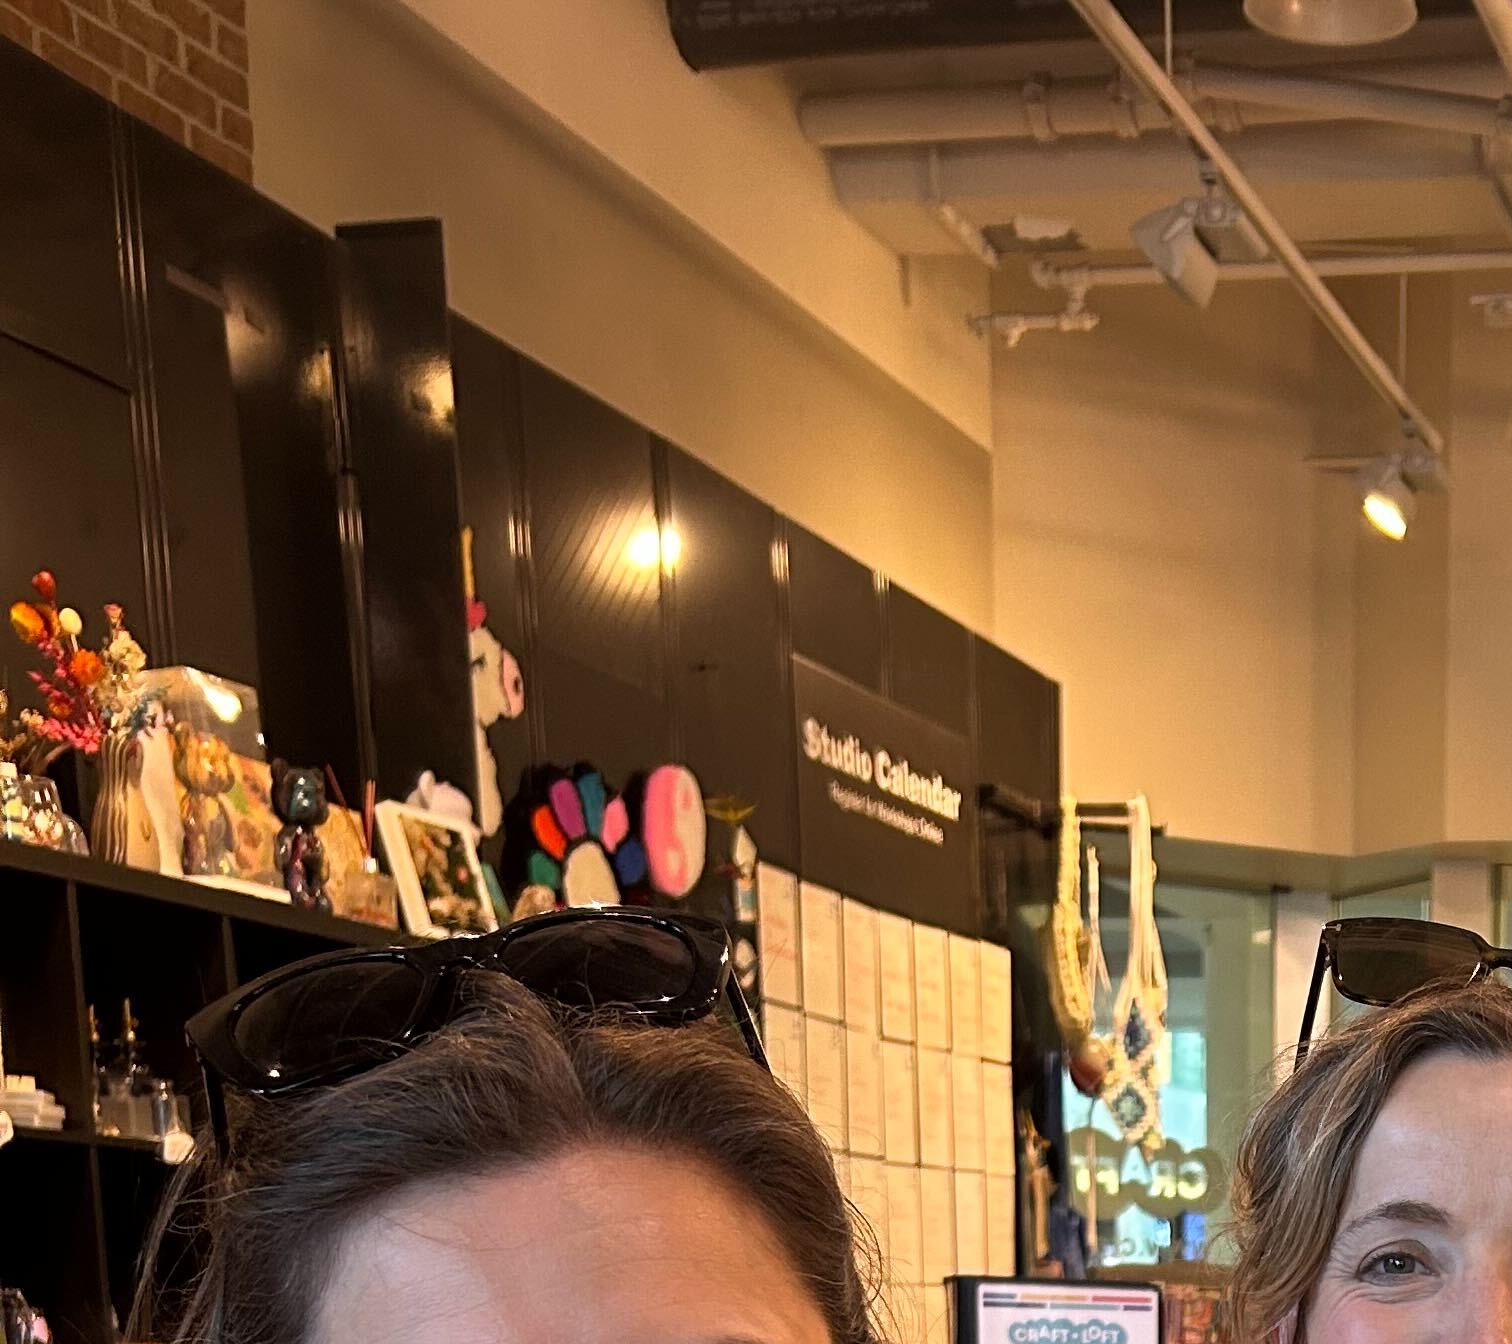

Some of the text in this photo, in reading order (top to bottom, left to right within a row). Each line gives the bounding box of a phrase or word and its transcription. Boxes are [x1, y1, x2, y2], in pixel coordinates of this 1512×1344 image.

[803, 717, 873, 784] Studio
[874, 750, 961, 821] Calendar
[1014, 1325, 1119, 1344] CRAFT LOFT
